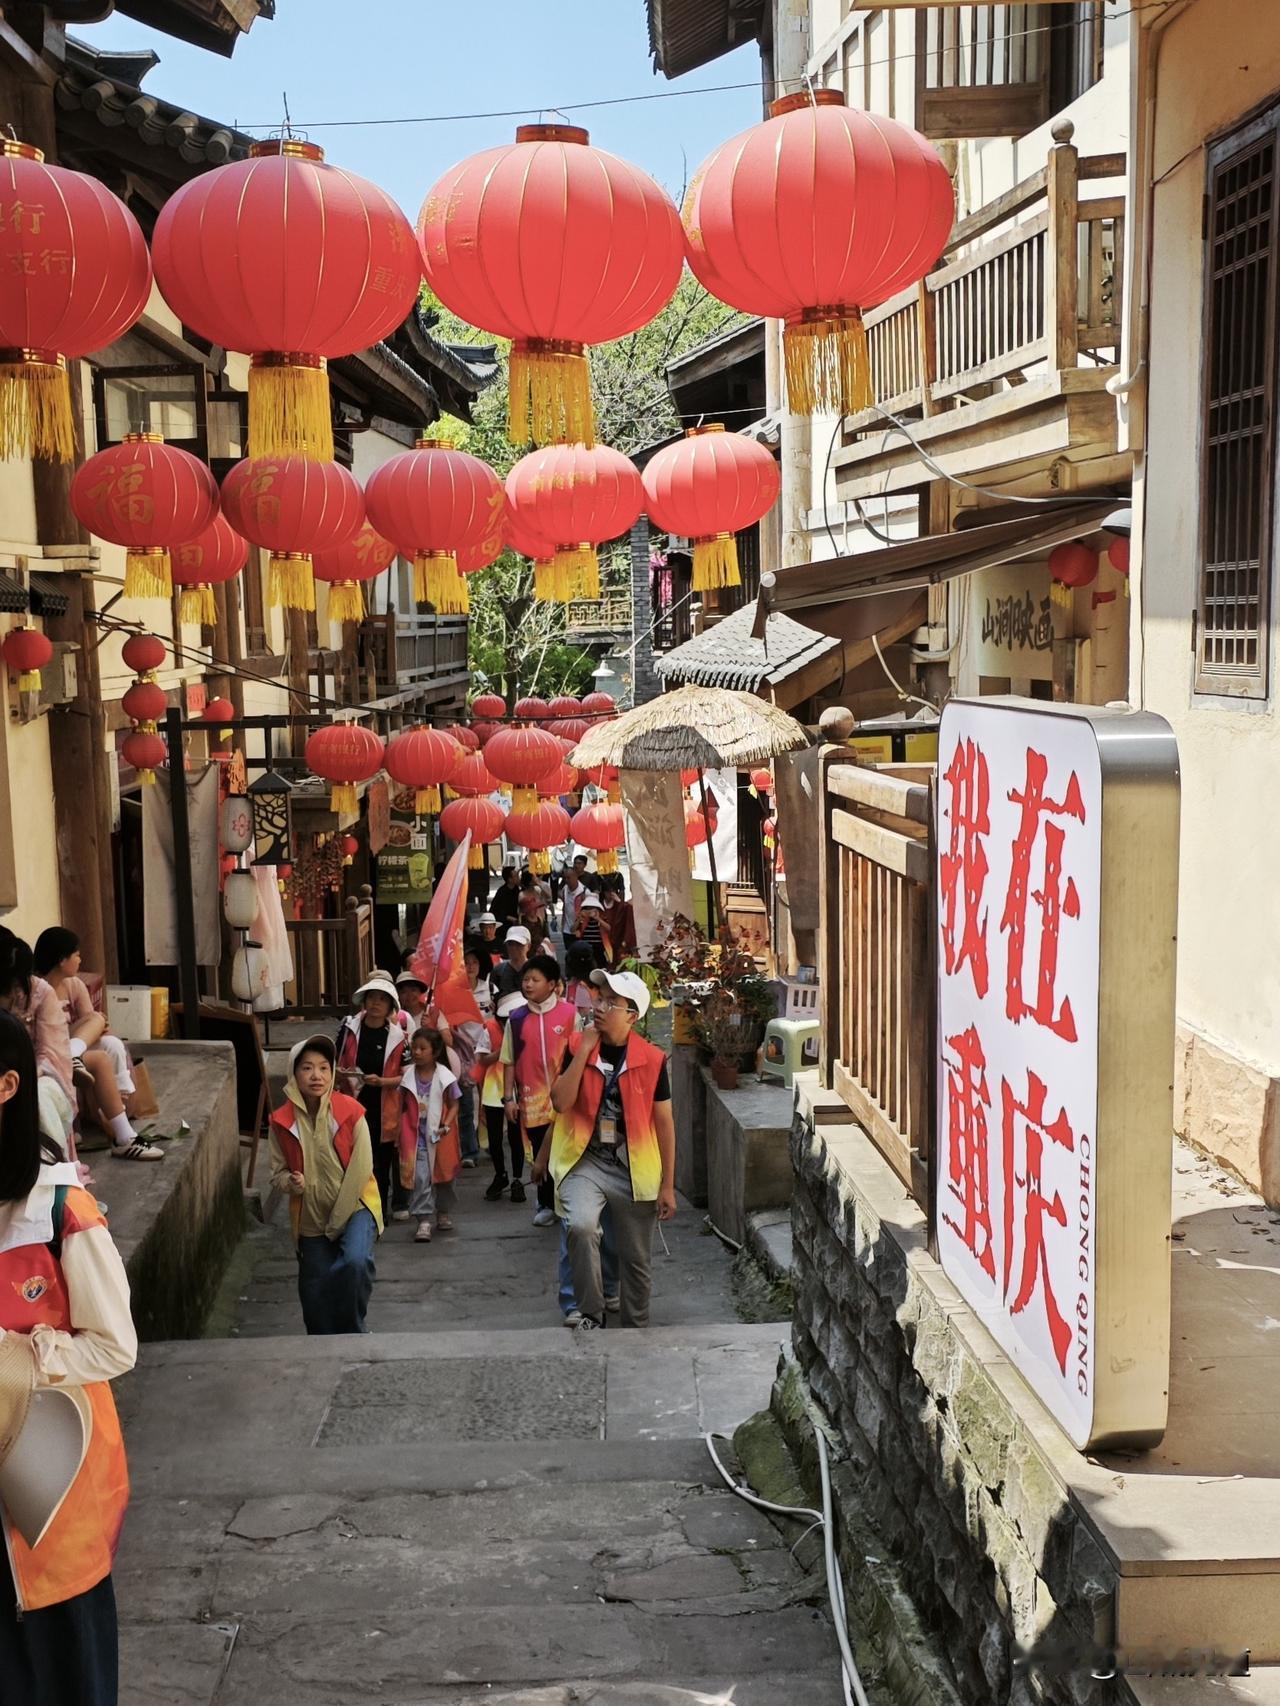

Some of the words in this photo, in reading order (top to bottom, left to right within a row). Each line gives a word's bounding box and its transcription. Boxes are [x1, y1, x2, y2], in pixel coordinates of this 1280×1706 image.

[85, 462, 155, 526] 福
[1078, 1133, 1091, 1282] CHONG
[1075, 1292, 1089, 1397] QING
